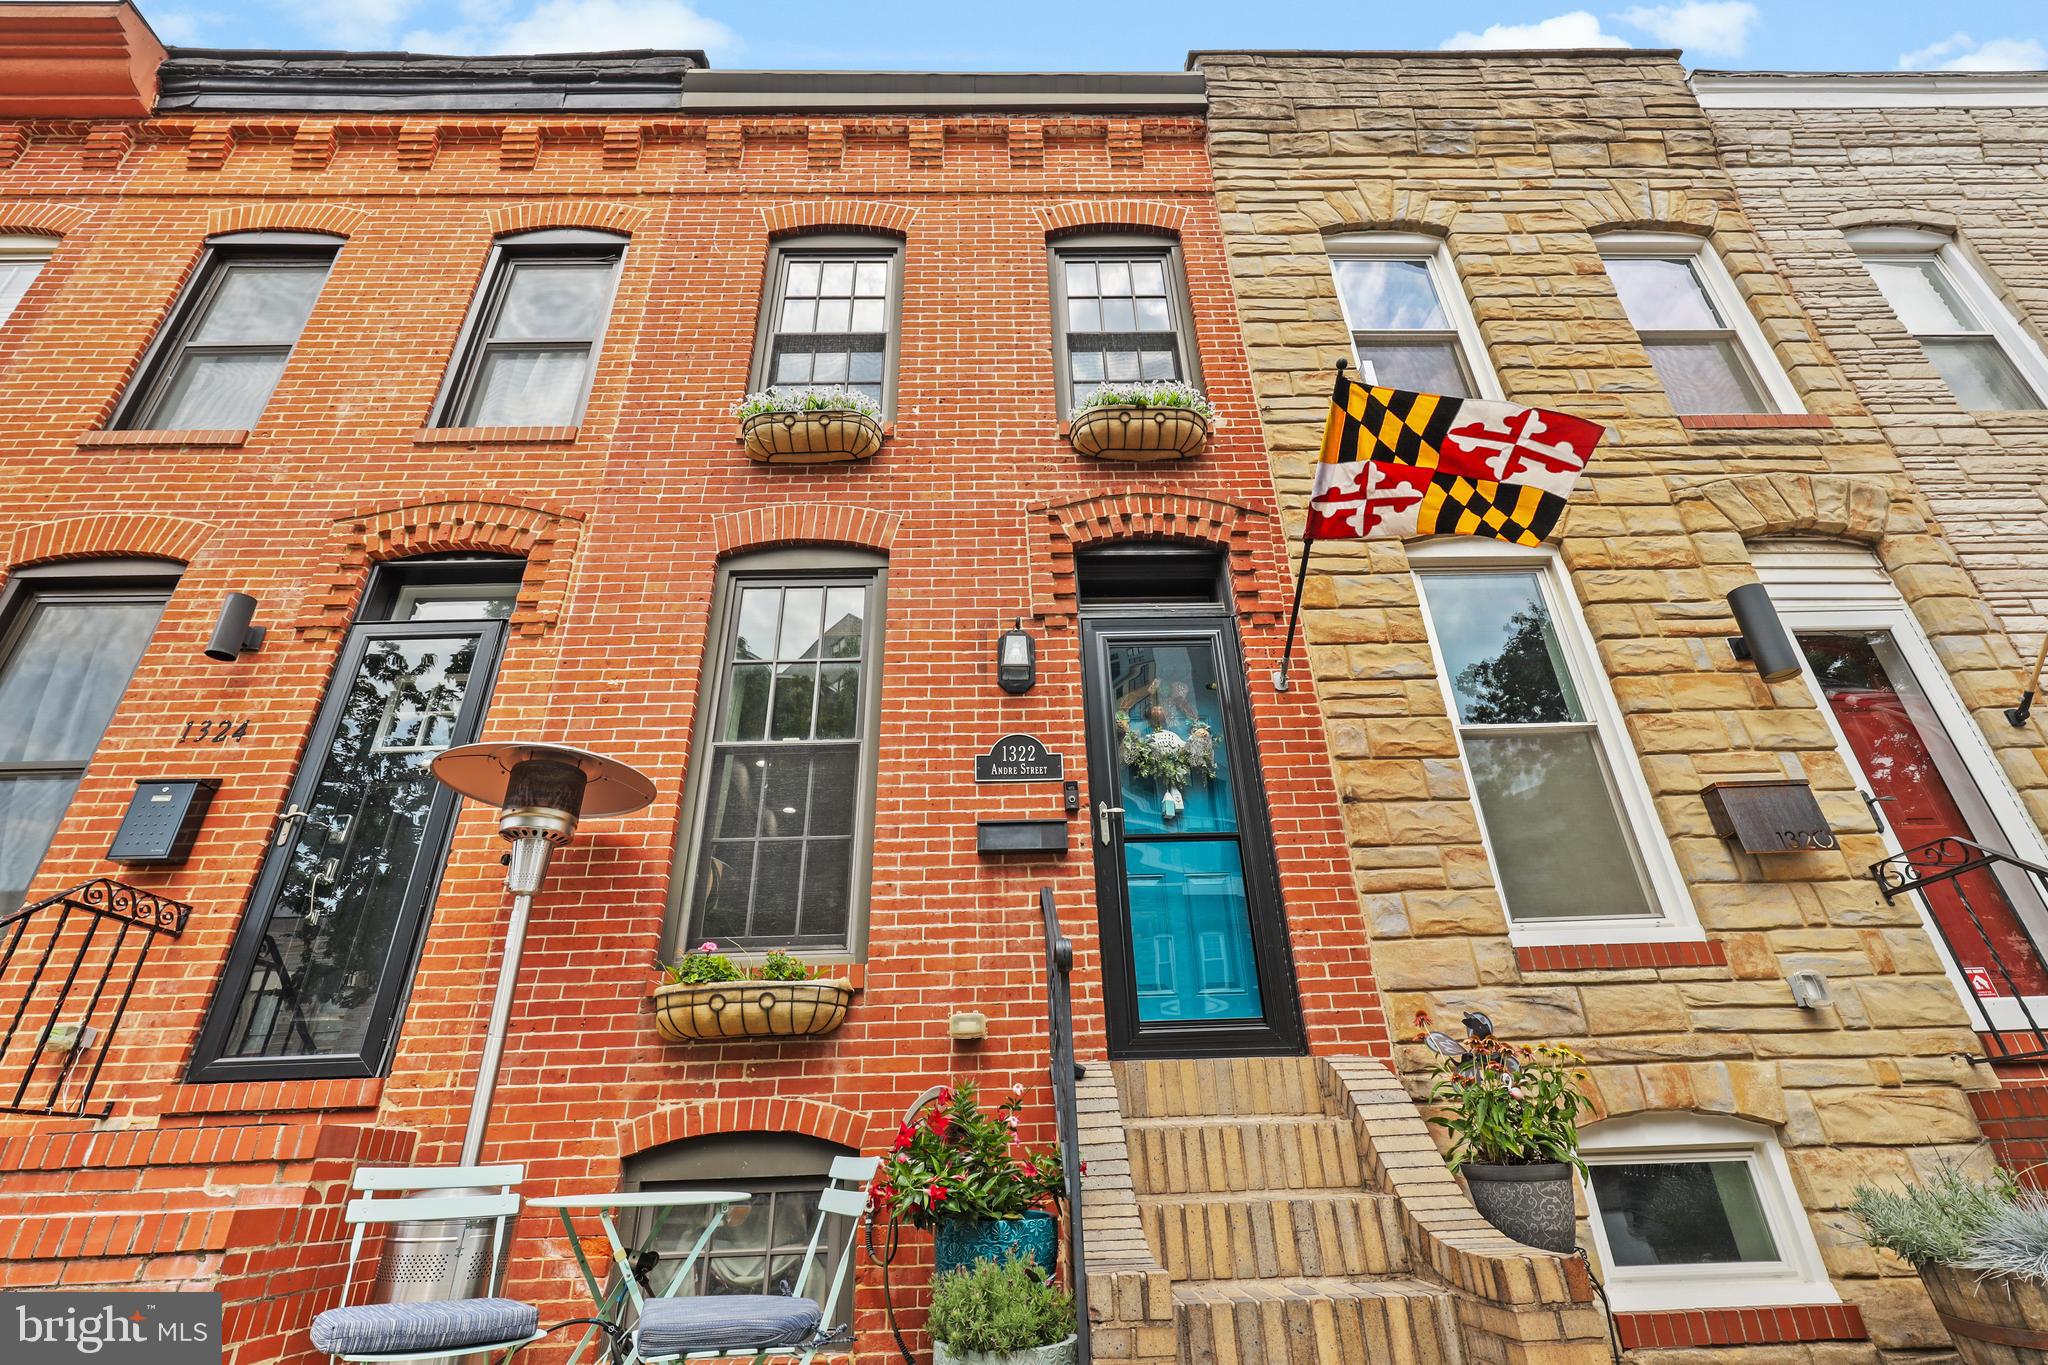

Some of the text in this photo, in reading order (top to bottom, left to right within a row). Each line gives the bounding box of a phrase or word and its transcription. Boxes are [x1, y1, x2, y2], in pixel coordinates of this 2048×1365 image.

[178, 719, 251, 744] 1324
[1002, 745, 1036, 762] 1322
[1775, 830, 1834, 849] 1320
